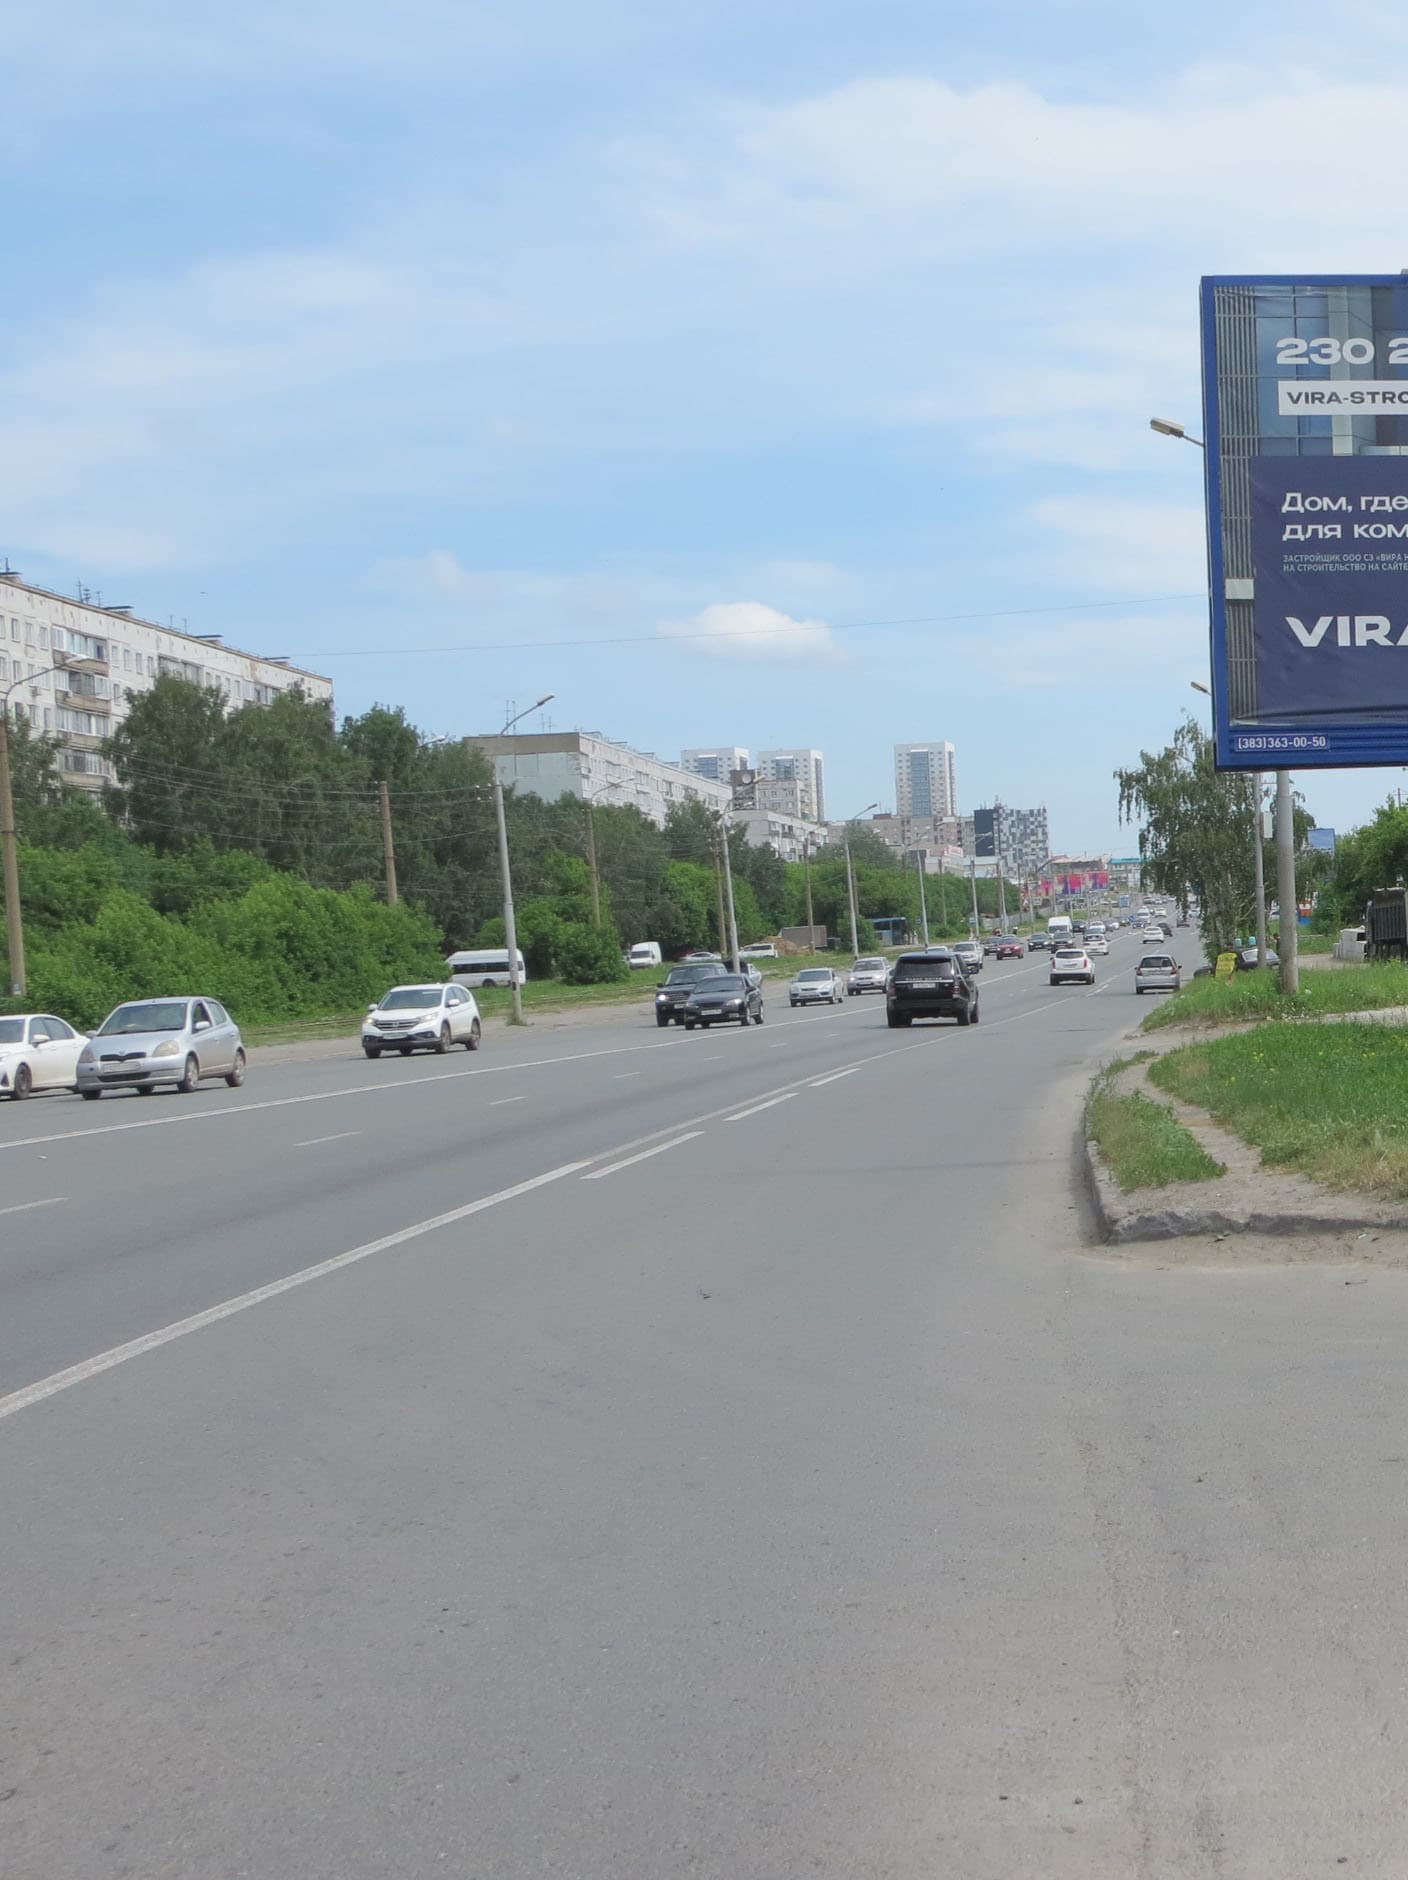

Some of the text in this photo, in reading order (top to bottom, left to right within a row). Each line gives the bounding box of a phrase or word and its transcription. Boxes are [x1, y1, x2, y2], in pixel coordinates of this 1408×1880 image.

[1276, 337, 1375, 365] 230
[1281, 492, 1353, 513] Дом,
[1282, 524, 1342, 542] для
[1283, 552, 1341, 563] ЗАСТРОЙЩИК
[1342, 553, 1361, 562] ООО
[1283, 564, 1295, 572] НА
[1296, 562, 1366, 572] СТРОИТЕЛЬСТВО
[1368, 562, 1380, 571] НА
[1381, 561, 1408, 571] САЙТЕ
[1238, 736, 1326, 749] (383)363-00-50
